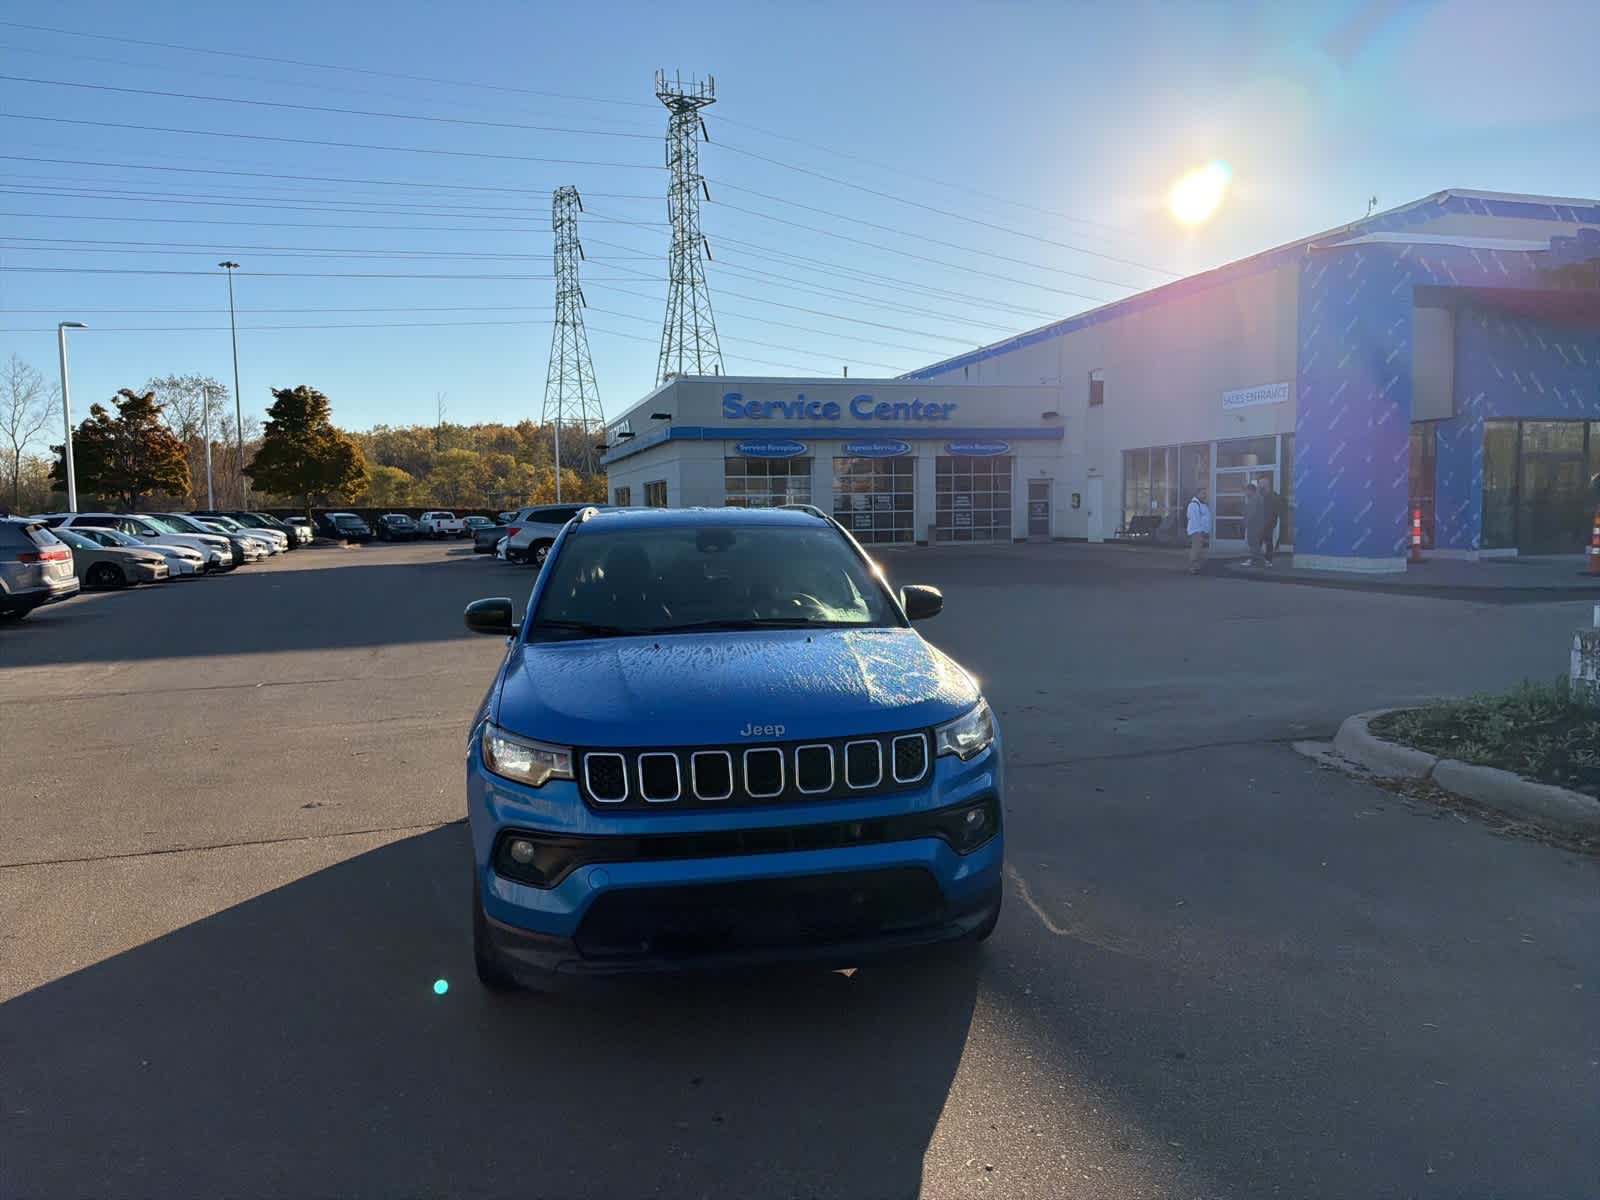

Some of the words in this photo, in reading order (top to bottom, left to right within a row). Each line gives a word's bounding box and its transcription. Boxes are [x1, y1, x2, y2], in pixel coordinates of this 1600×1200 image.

[722, 392, 840, 420] Service
[850, 394, 956, 421] Center
[740, 723, 786, 737] Jeep
